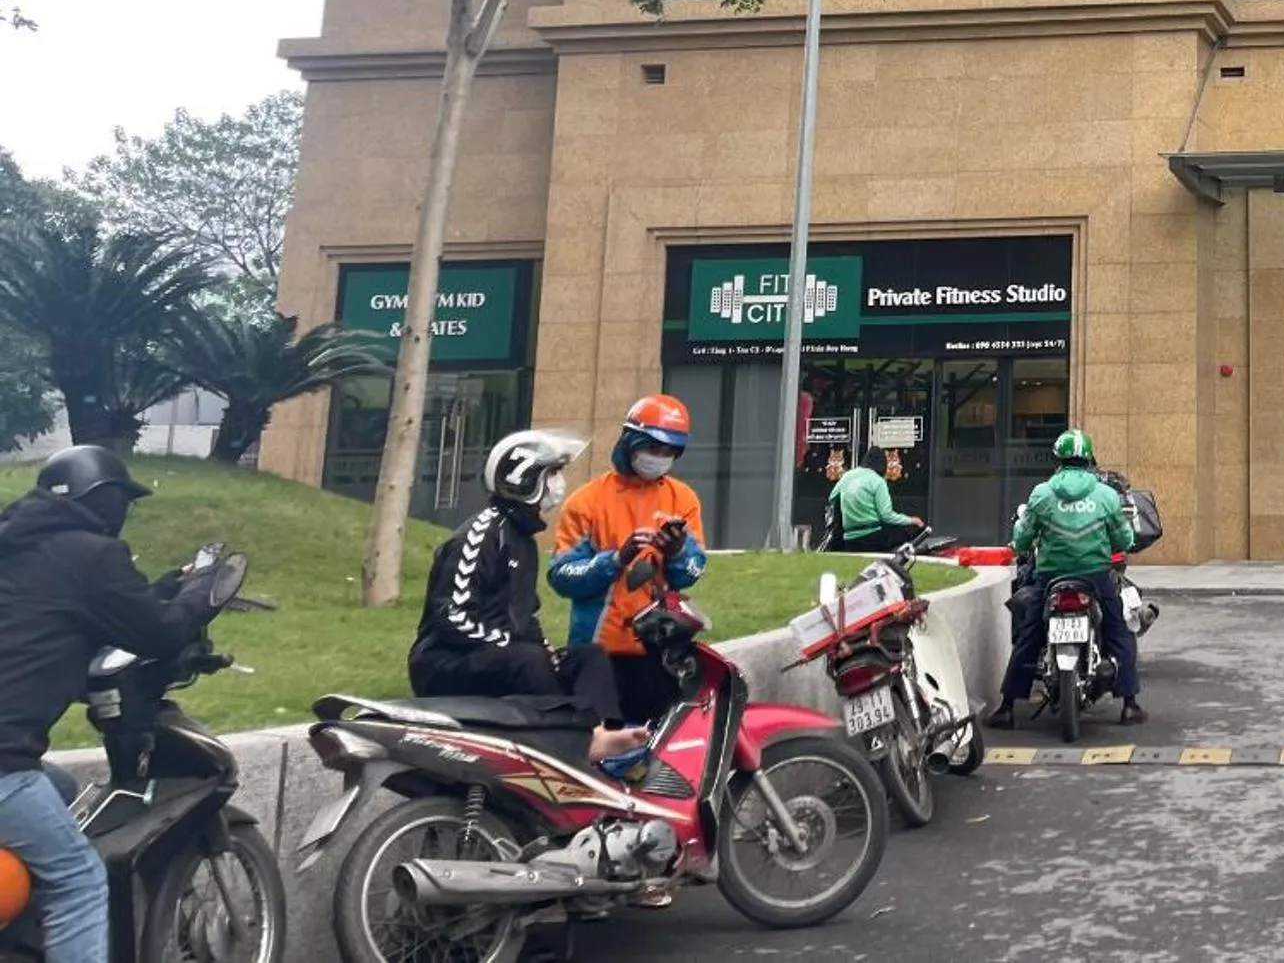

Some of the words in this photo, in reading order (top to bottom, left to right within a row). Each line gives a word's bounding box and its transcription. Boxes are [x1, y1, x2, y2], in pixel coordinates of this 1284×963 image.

[760, 274, 789, 293] FIT
[370, 294, 408, 310] GYM
[457, 293, 485, 308] KID
[868, 287, 932, 307] Private
[936, 285, 1002, 305] Fitness
[1006, 283, 1067, 304] Studio
[747, 304, 786, 323] CIT
[505, 447, 539, 485] 7
[1057, 496, 1097, 514] Grab
